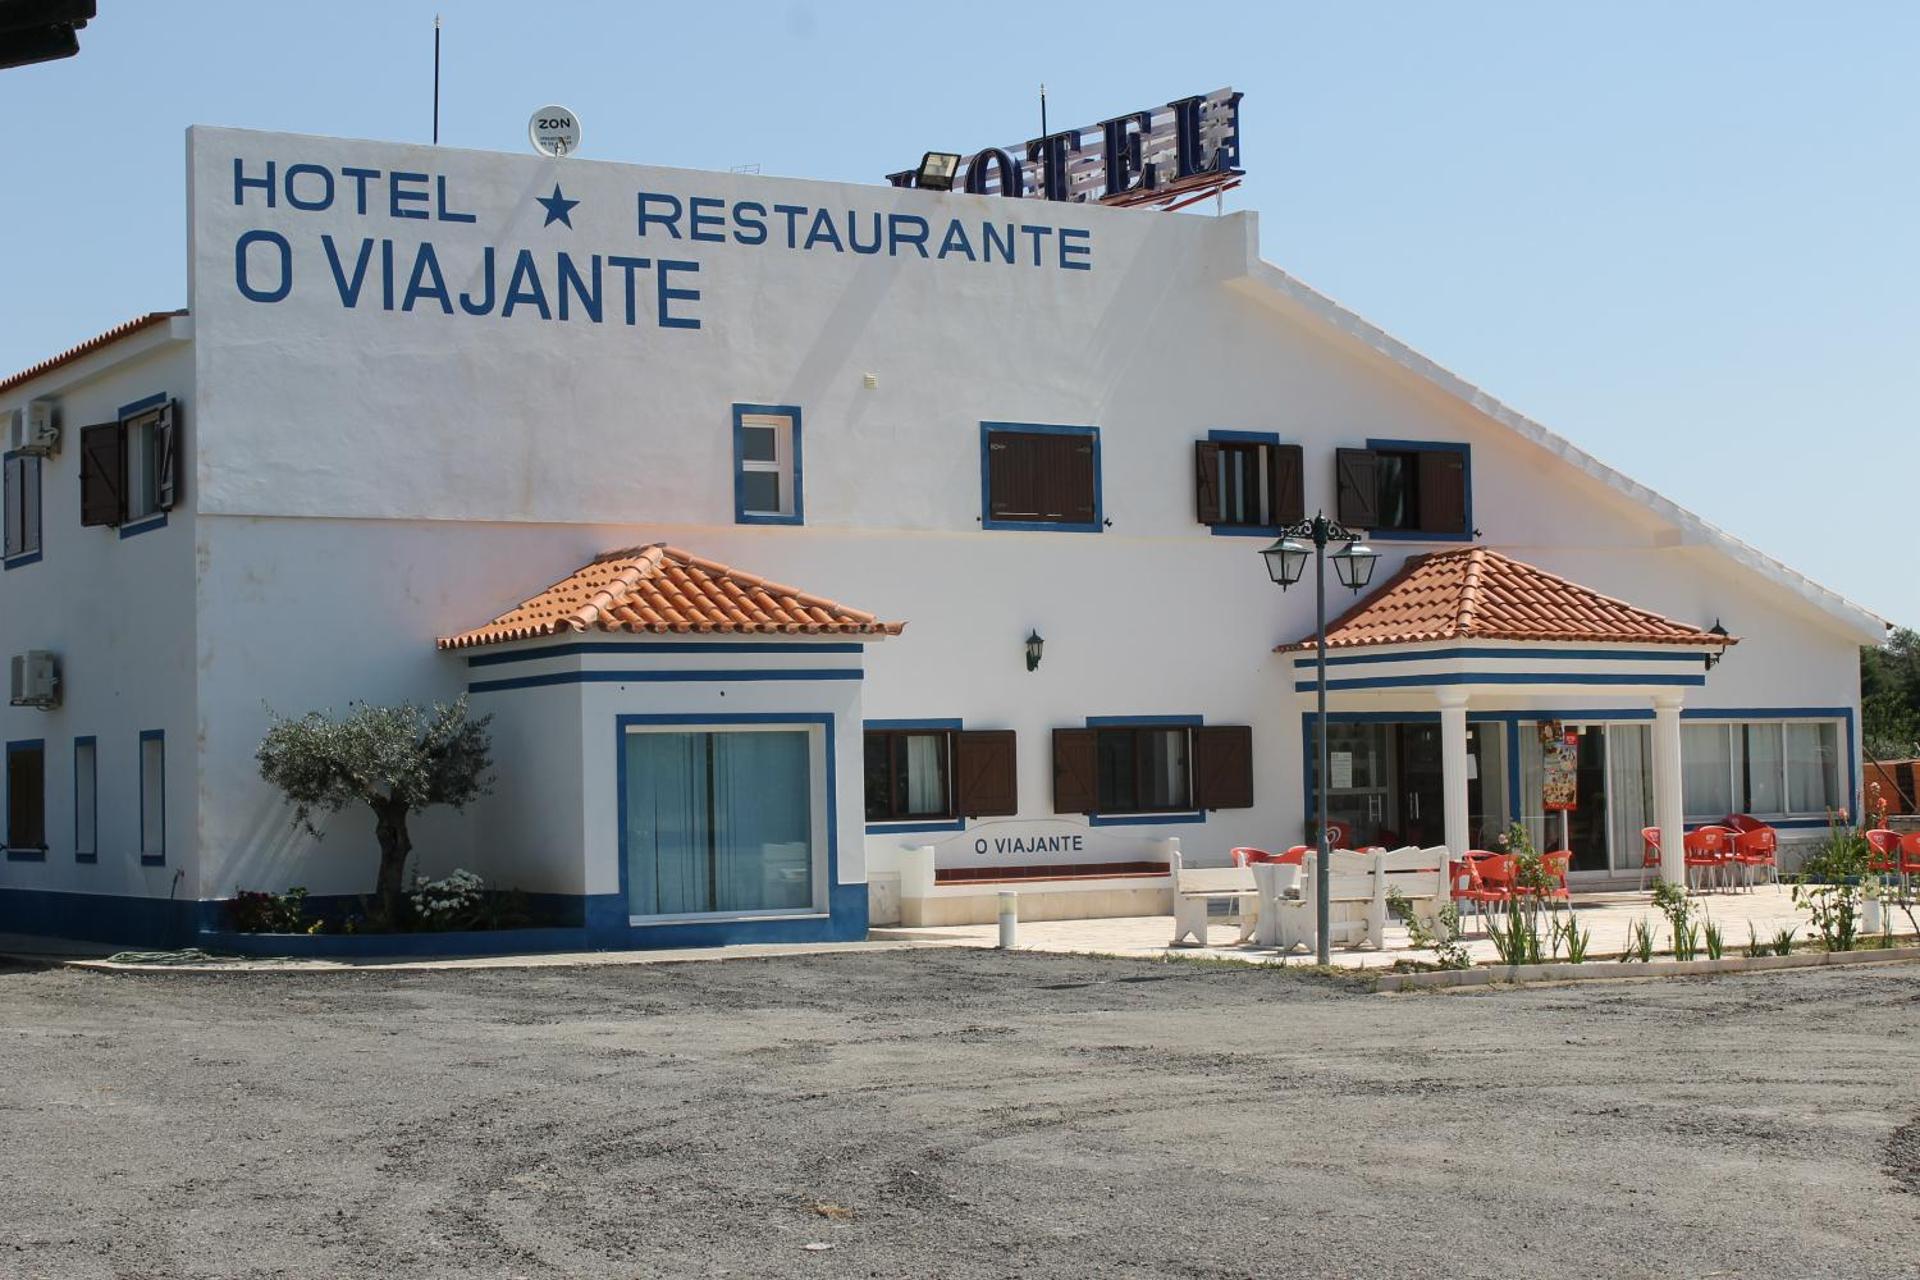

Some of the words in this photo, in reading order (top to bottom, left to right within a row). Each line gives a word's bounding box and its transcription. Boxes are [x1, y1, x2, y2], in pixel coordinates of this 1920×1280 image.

[538, 118, 571, 130] ZON
[885, 95, 1231, 203] OTEL
[234, 158, 477, 223] HOTEL
[638, 192, 1091, 271] RESTAURANTE
[235, 230, 293, 304] O
[321, 235, 701, 330] VIAJANTE
[975, 838, 988, 855] O
[995, 835, 1084, 854] VIAJANTE
